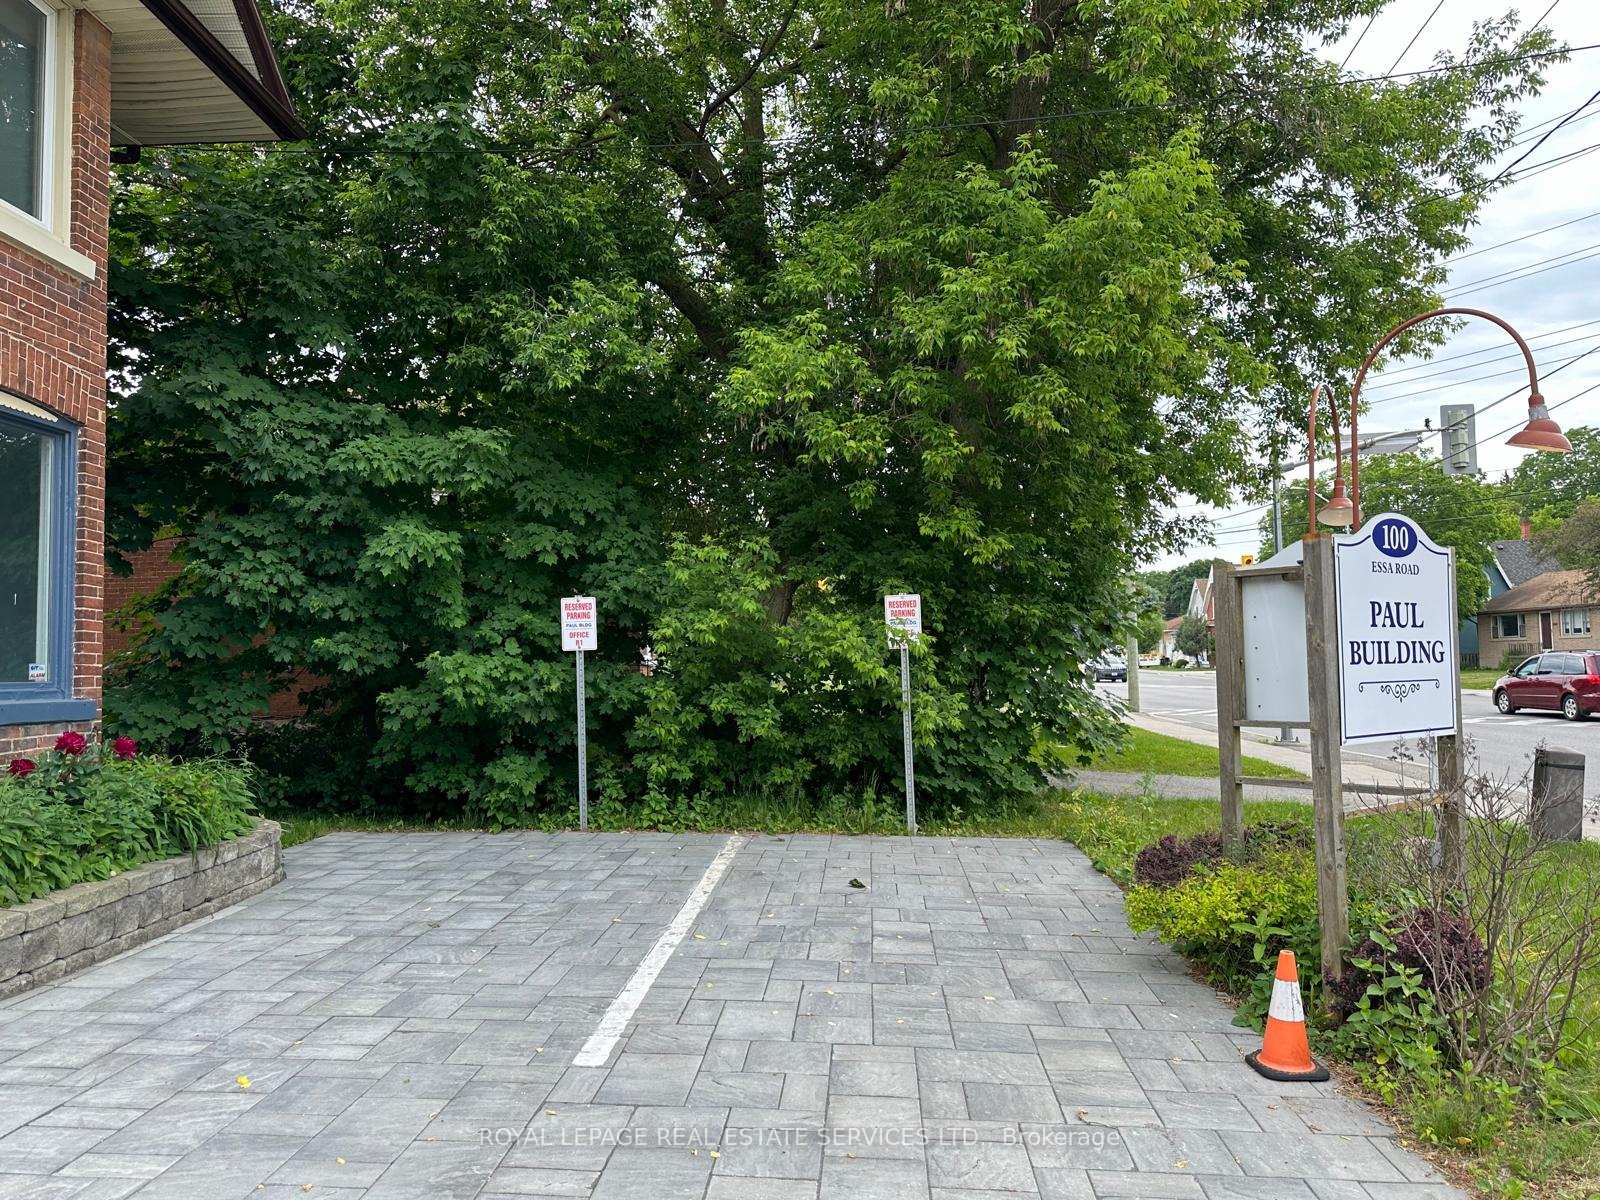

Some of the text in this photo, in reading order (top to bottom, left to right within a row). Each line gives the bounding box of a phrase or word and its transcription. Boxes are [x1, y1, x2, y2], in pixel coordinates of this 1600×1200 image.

[1382, 525, 1410, 551] 100
[1371, 561, 1420, 576] ESSA ROAD
[564, 602, 593, 611] RESERVED
[888, 600, 917, 609] RESERVED
[566, 612, 591, 620] PARKING
[890, 609, 916, 618] PARKING
[1369, 600, 1424, 629] PAUL
[1349, 640, 1445, 666] BUILDING
